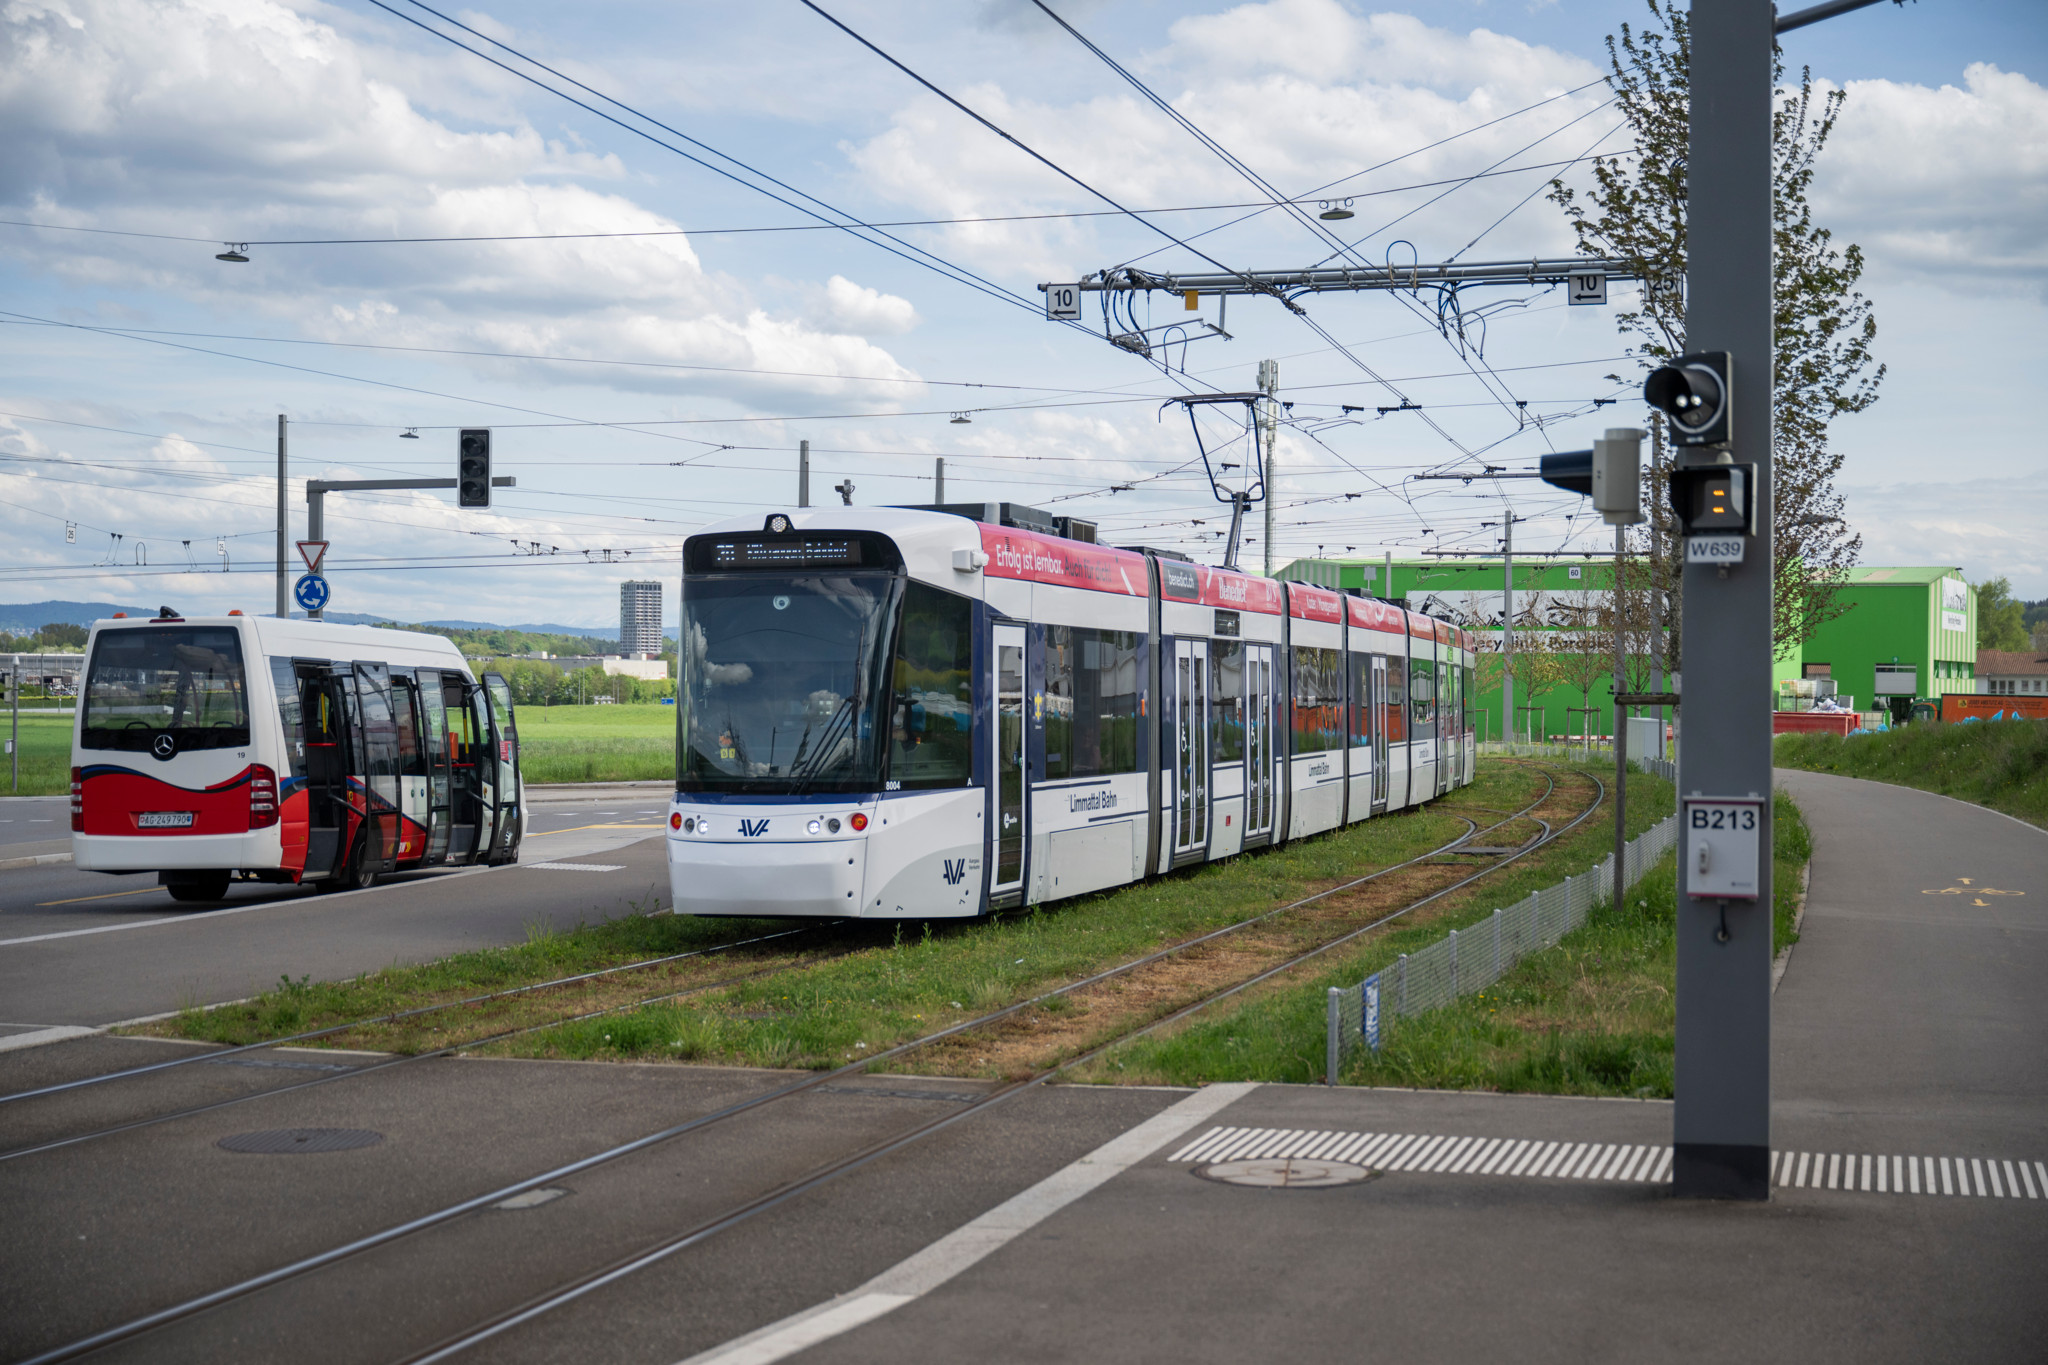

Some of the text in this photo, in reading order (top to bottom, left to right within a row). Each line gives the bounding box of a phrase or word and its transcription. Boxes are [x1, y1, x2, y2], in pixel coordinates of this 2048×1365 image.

[1054, 289, 1072, 307] 10
[996, 544, 1021, 575] Erfolg
[1022, 549, 1033, 570] ist
[1034, 551, 1064, 575] lernbar.
[1065, 557, 1083, 577] Auch
[1083, 558, 1093, 579] für
[1168, 570, 1195, 589] benedict.ch
[1570, 569, 1579, 577] 60
[885, 780, 901, 791] 8004
[966, 777, 973, 787] A
[1070, 790, 1117, 813] Limmattal Bahn
[1692, 809, 1755, 830] B213
